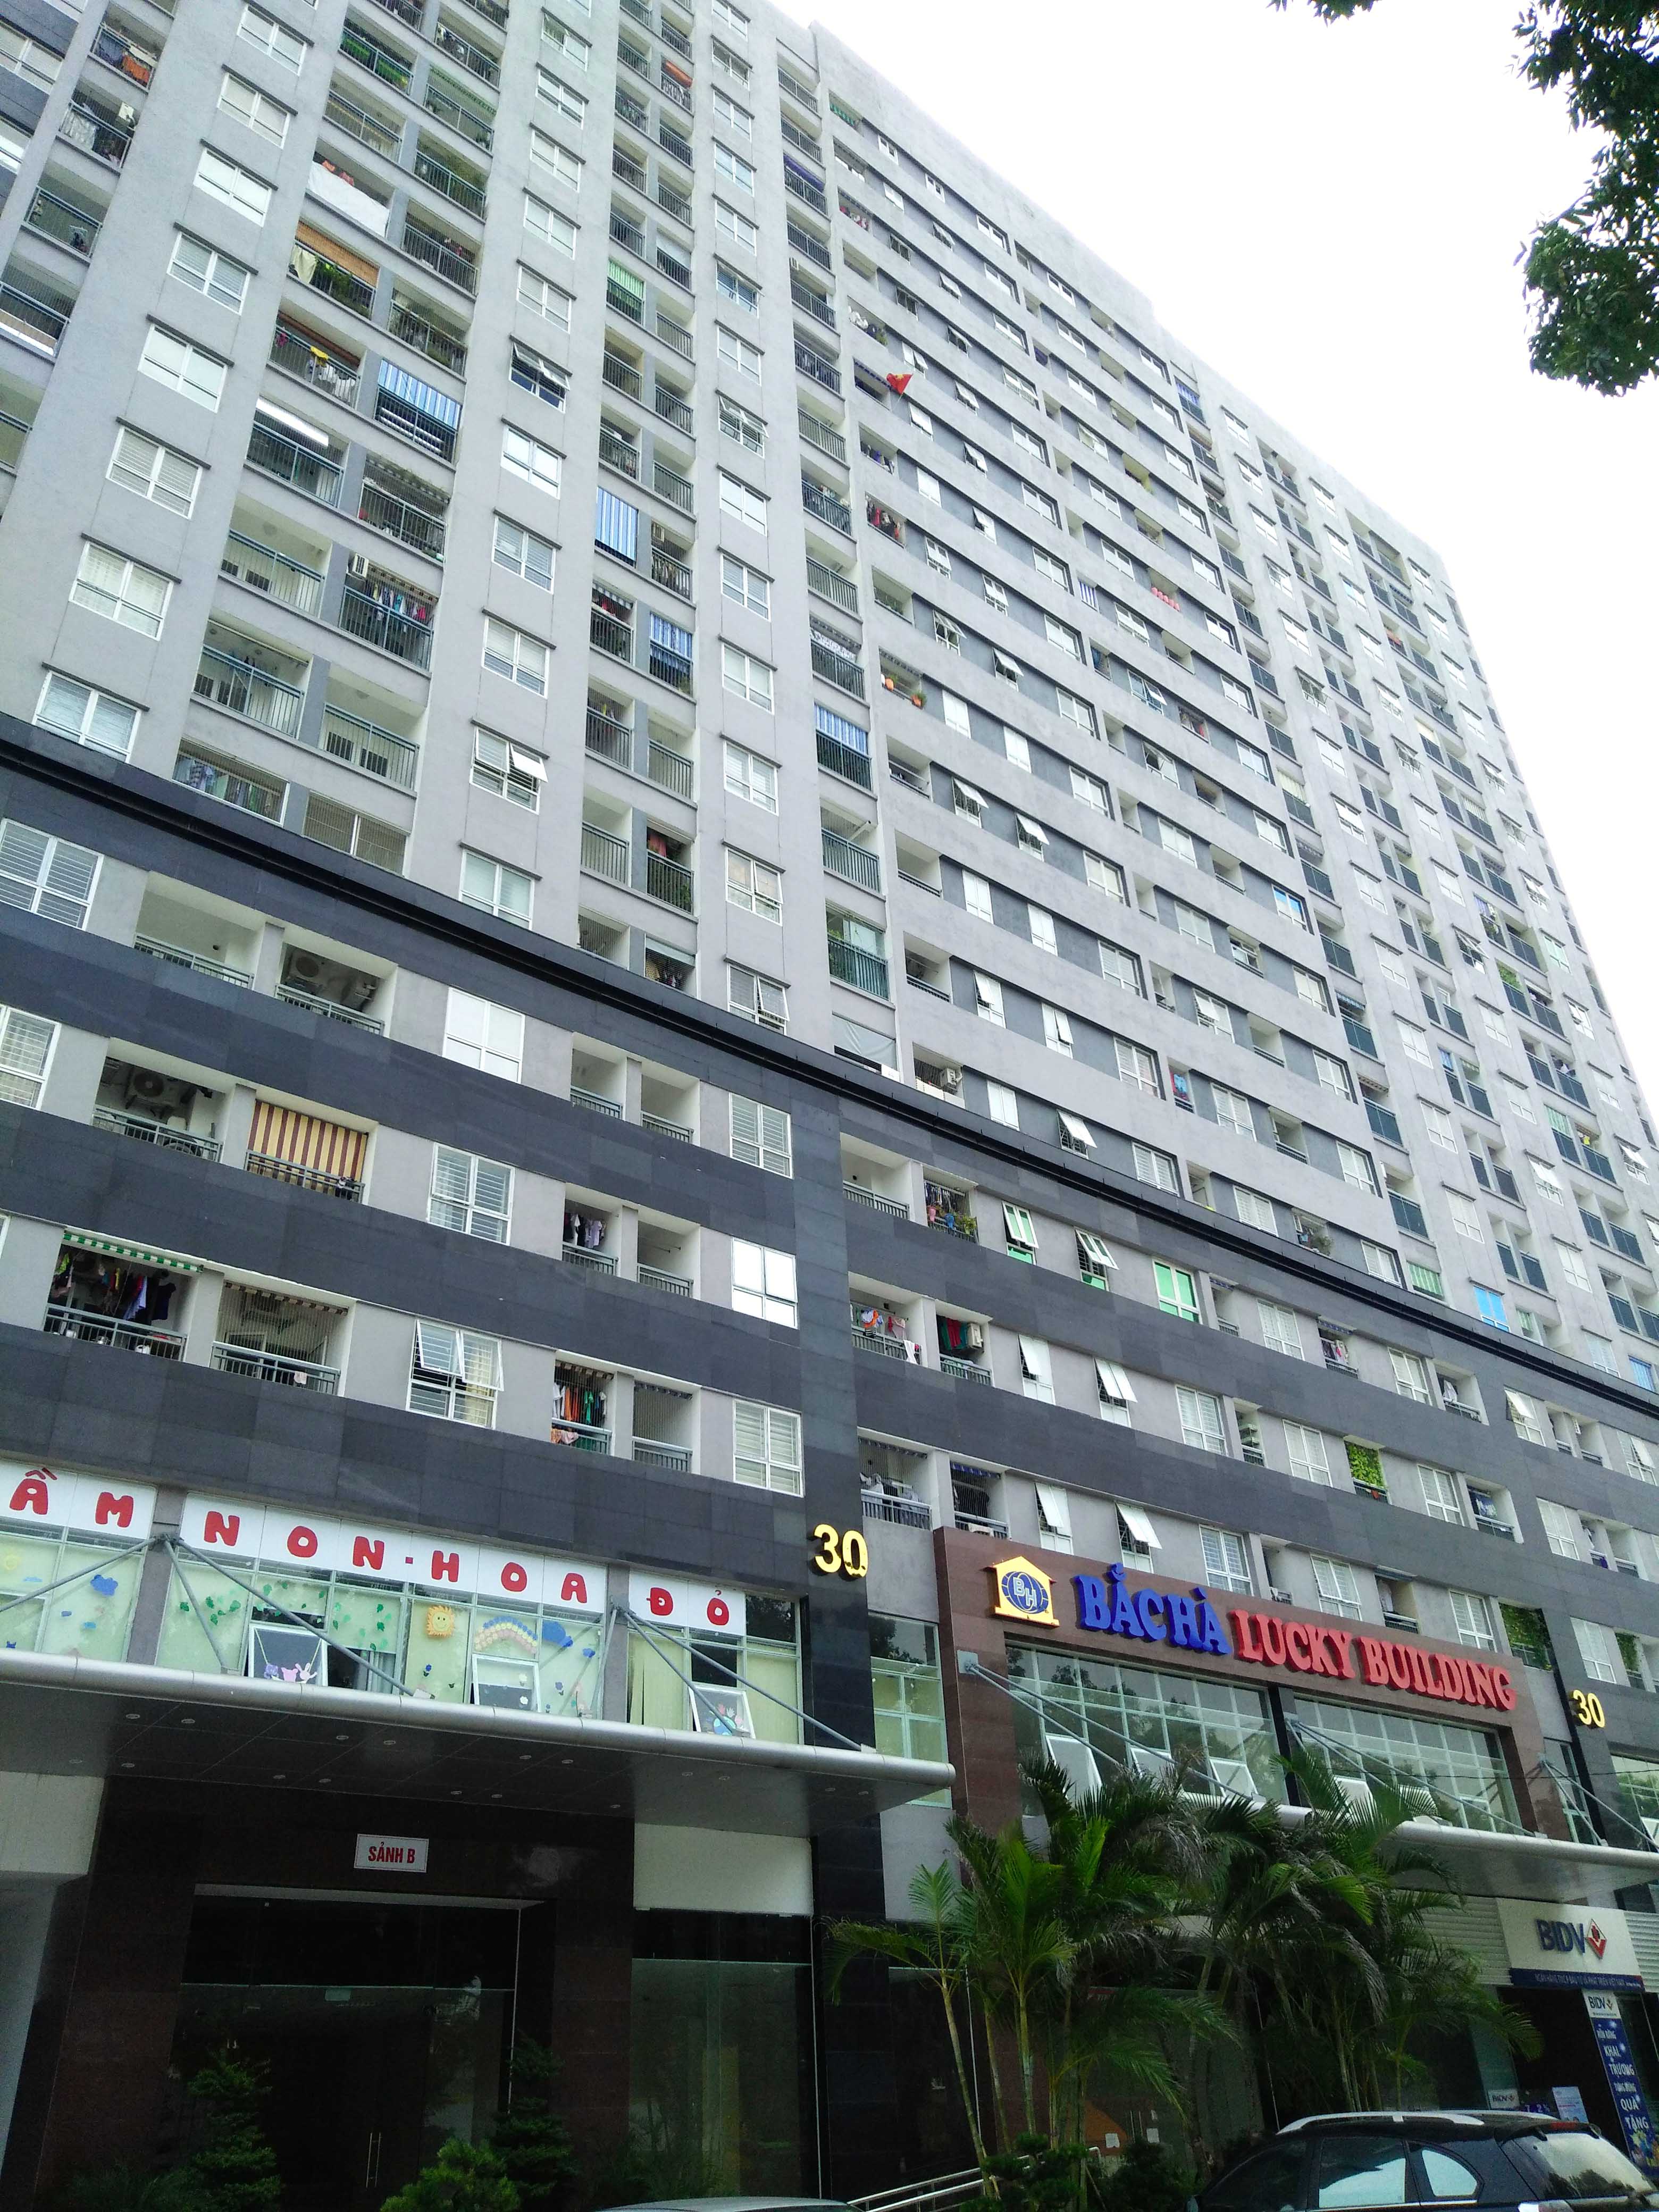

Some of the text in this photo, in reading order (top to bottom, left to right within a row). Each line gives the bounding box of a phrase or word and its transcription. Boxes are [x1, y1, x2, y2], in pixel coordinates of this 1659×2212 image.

[812, 1523, 869, 1578] 30
[646, 1587, 730, 1626] ĐỎ
[1012, 1576, 1038, 1608] BH
[1227, 1608, 1356, 1680] LUCKY
[1357, 1636, 1518, 1712] BUILDING
[1572, 1689, 1605, 1728] 30
[368, 1841, 416, 1864] SẢNH B
[1535, 1918, 1586, 1954] BIDV
[1588, 1996, 1606, 2009] BIDV
